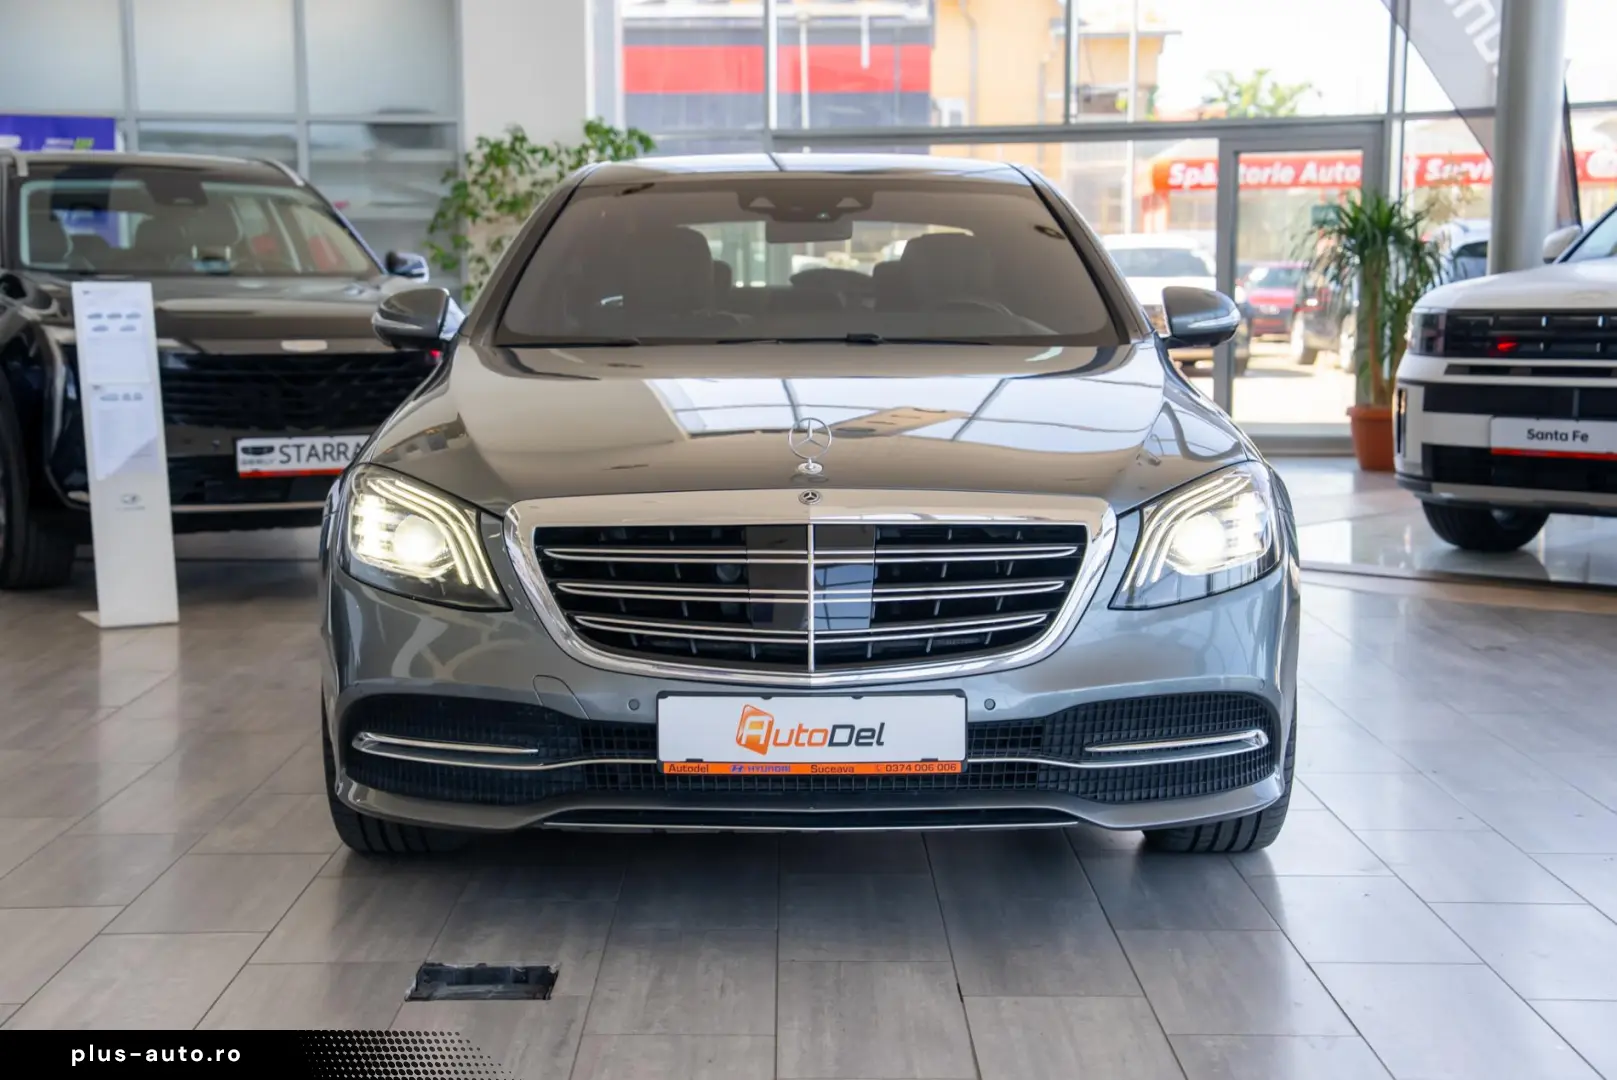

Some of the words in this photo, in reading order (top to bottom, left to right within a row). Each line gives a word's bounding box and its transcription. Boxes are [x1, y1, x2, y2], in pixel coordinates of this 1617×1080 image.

[1299, 159, 1362, 184] Auto
[1526, 428, 1569, 442] Santa
[1572, 430, 1589, 443] Fe
[736, 705, 885, 754] AutoDel
[668, 763, 709, 773] Autodel
[747, 764, 791, 773] HYUNDAI
[810, 764, 855, 773] Suceava
[885, 763, 912, 773] 0374
[914, 763, 934, 772] 006
[936, 763, 957, 772] 006
